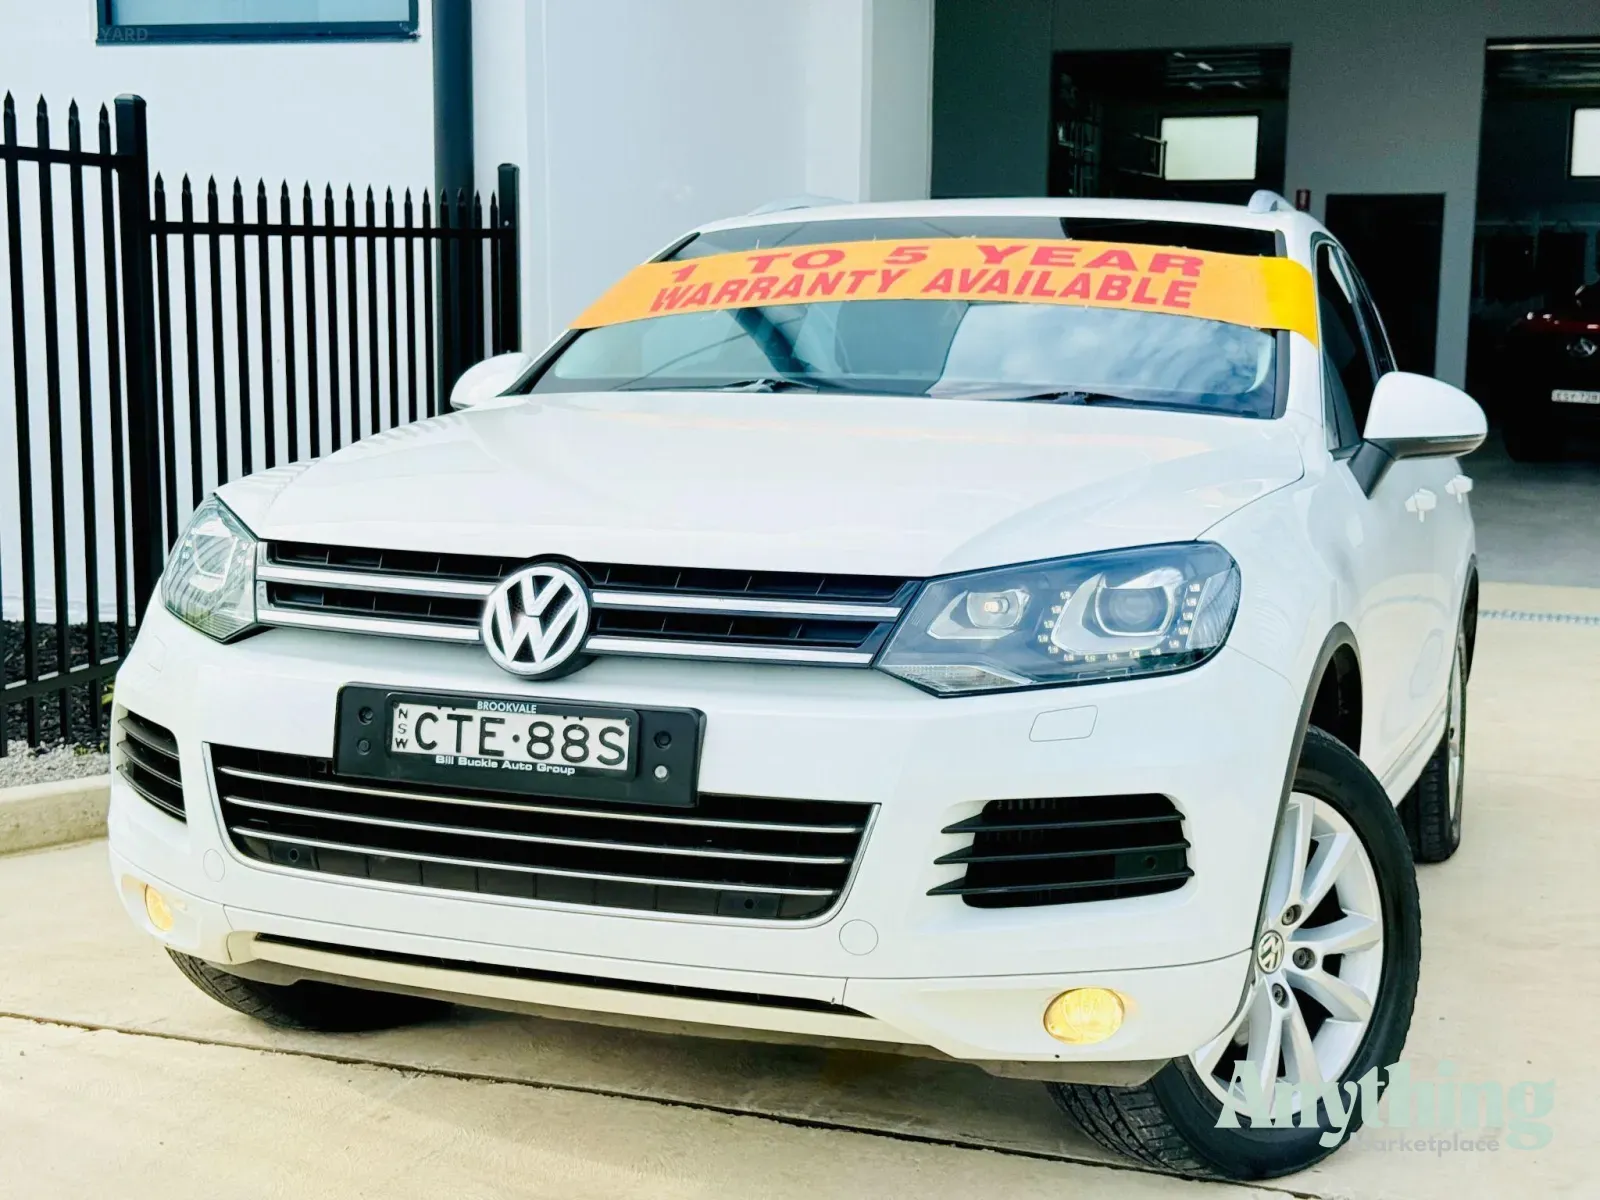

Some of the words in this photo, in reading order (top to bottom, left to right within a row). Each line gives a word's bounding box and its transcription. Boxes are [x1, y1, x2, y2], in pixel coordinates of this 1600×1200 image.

[671, 263, 699, 283] 1
[746, 249, 848, 274] TO
[883, 246, 931, 265] 5
[977, 245, 1205, 277] YEAR
[649, 268, 919, 312] WARRANTY
[920, 268, 1197, 309] AVAILABLE
[477, 700, 537, 714] BROOKVALE
[435, 754, 455, 766] Bill
[458, 757, 499, 769] Buckle
[501, 760, 534, 772] Auto
[536, 763, 576, 776] Group
